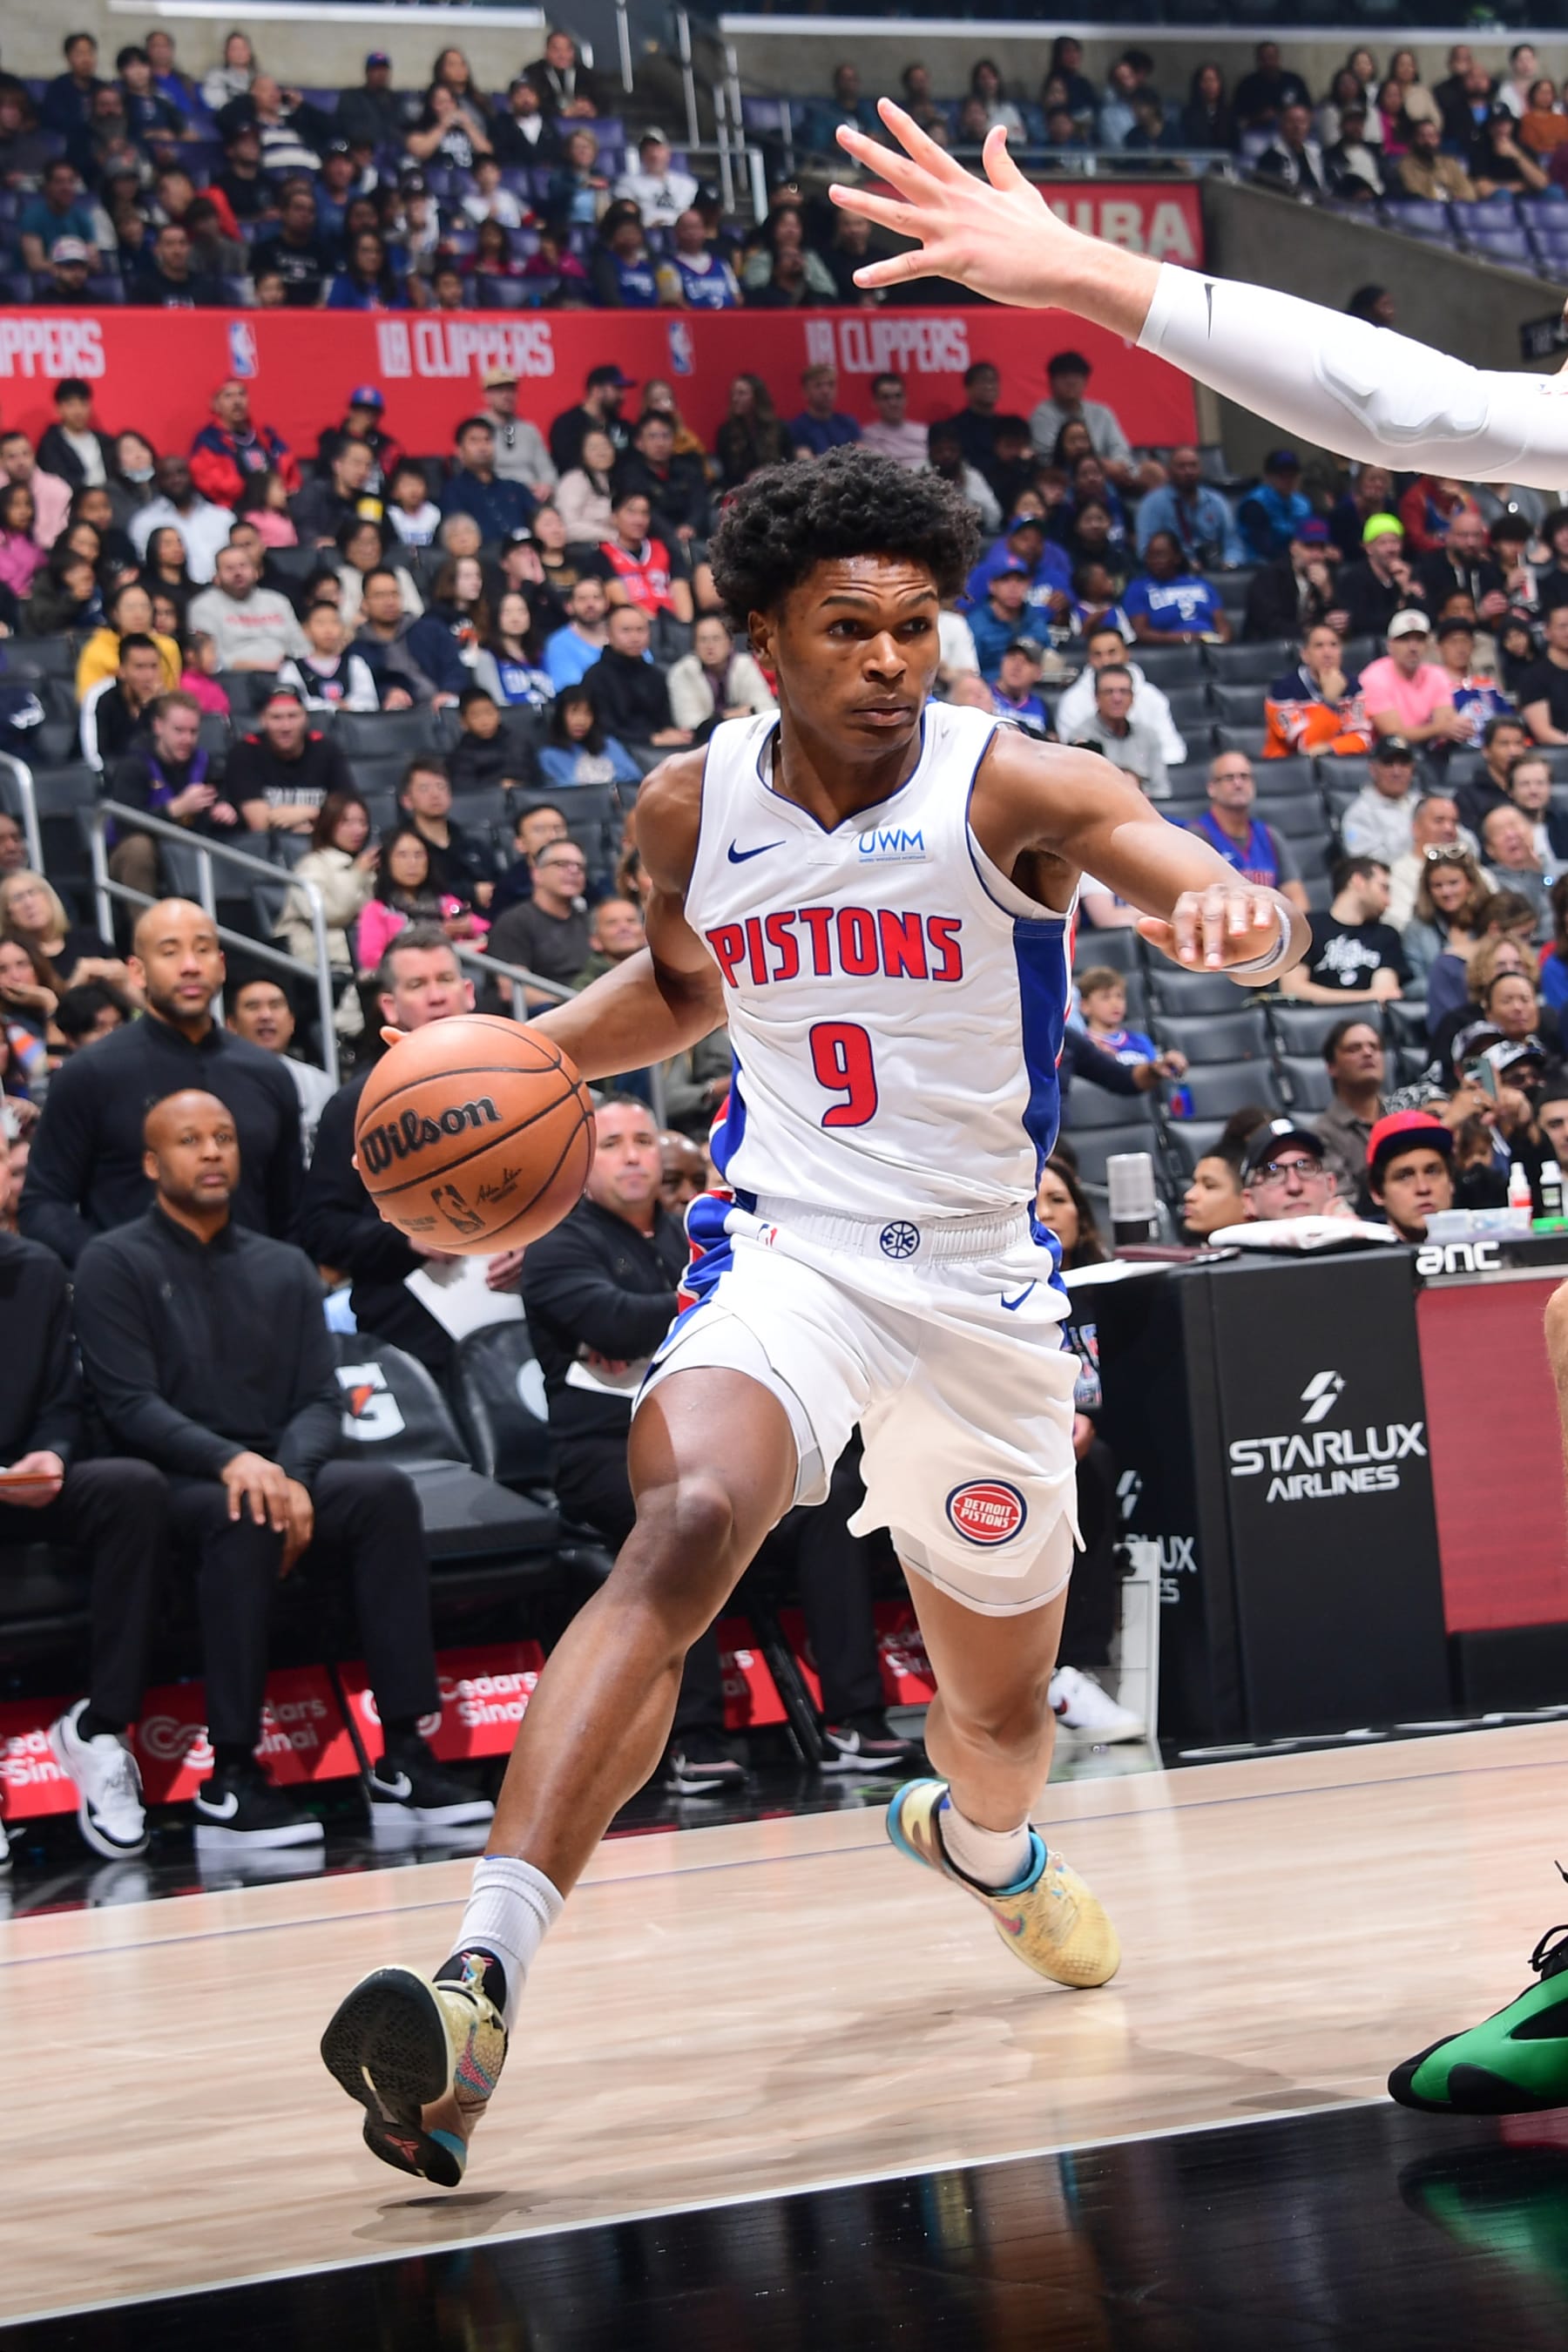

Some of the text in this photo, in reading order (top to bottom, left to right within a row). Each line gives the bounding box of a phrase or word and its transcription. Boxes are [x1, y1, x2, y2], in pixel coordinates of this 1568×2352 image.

[414, 320, 555, 377] CLIPPERS
[839, 320, 970, 373] CLIPPERS
[858, 829, 925, 853] UWM
[705, 907, 963, 989] PISTONS
[809, 1021, 878, 1127] 9
[360, 1095, 503, 1175] Wilson
[1229, 1422, 1428, 1477] STARLUX
[963, 1497, 1012, 1517] DETROIT
[1266, 1464, 1401, 1504] AIRLINES
[960, 1508, 1010, 1529] PISTONS
